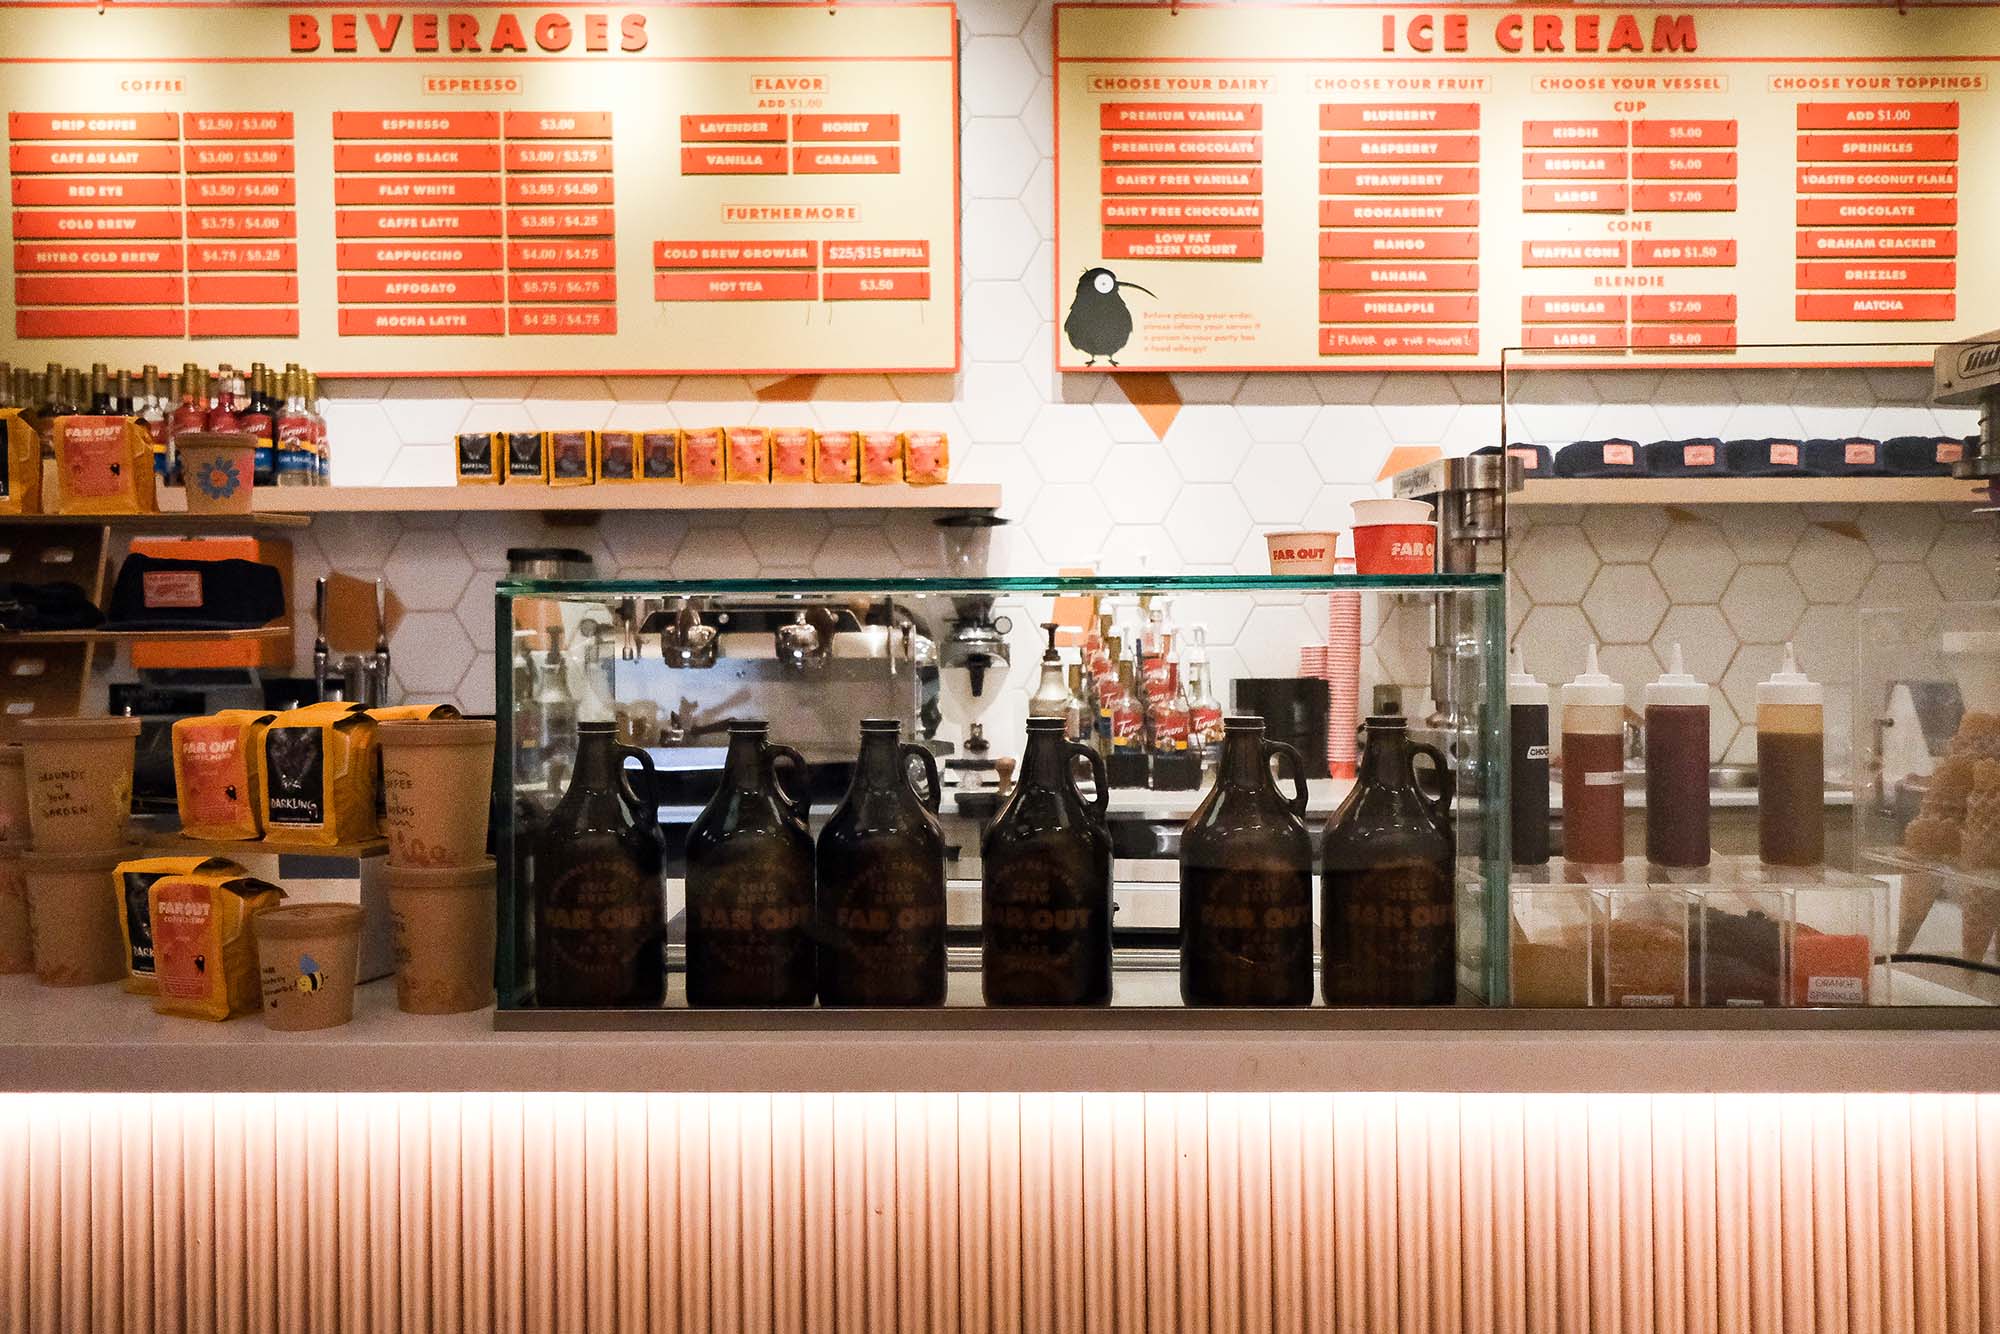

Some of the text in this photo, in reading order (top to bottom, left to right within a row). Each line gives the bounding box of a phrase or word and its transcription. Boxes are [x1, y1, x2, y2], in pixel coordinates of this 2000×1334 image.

[289, 13, 648, 52] BEVERAGES
[1382, 14, 1699, 52] ICE CREAM
[121, 80, 183, 92] COFFEE
[428, 79, 519, 91] ESPRESSO
[756, 79, 824, 90] FLAVOR
[1095, 79, 1268, 89] CHOOSE YOUR DAIRY
[1314, 79, 1485, 89] CHOOSE YOUR FRUIT
[1540, 79, 1720, 89] CHOOSE YOUR VESSEL
[1774, 77, 1982, 89] CHOOSE YOUR TOPPINGS
[758, 99, 822, 109] ADD $1.00
[1614, 101, 1647, 112] CUP
[1120, 112, 1244, 121] PREMIUM VANILLA
[1363, 110, 1437, 121] BLUEBERRY
[1847, 110, 1911, 121] ADD $1.00
[51, 120, 136, 130] DRIP COFFEE
[382, 120, 450, 130] ESPRESSO
[700, 123, 768, 133] LAVENDER
[822, 122, 869, 132] HONEY
[1112, 143, 1254, 153] PREMIUM CHOCOLATE
[1361, 143, 1438, 154] RASPBERRY
[1842, 143, 1913, 153] SPRINKLES
[51, 153, 139, 163] CAFE AU LAIT
[375, 152, 459, 162] LONG BLACK
[707, 155, 763, 165] VANILLA
[816, 155, 878, 165] CARAMEL
[1545, 160, 1606, 170] REGULAR
[1116, 176, 1249, 185] DAIRY FREE VANILLA
[1356, 175, 1444, 186] STRAWBERRY
[1802, 175, 1854, 185] TOASTED
[1858, 175, 1914, 185] COCONUT
[69, 186, 123, 197] RED EYE
[379, 185, 455, 195] FLAT WHITE
[1554, 191, 1598, 202] LARGE
[1669, 192, 1702, 202] $7.00
[727, 208, 856, 220] FURTHERMORE
[1107, 207, 1259, 217] DAIRY FREE CHOCOLATE
[1840, 206, 1915, 216] CHOCOLATE
[58, 219, 136, 229] COLD BREW
[378, 218, 459, 228] CAFFE LATTE
[1608, 221, 1653, 232] CONE
[1155, 234, 1211, 243] LOW FAT
[1373, 240, 1425, 250] MANGO
[1817, 239, 1936, 249] GRAHAM CRACKER
[522, 249, 599, 260] $4.00 $4.75
[664, 248, 808, 259] COLD BREW GROWLER
[829, 247, 924, 261] $25/$15 REFILL
[1129, 245, 1237, 255] FROZEN YOGURT
[1531, 248, 1620, 258] WAFFLE CONE
[1653, 248, 1681, 258] ADD
[37, 253, 160, 262] NITRO COLD BREW
[377, 251, 463, 261] CAPPUCCINO
[1371, 271, 1428, 282] BANANA
[1845, 270, 1907, 280] DRIZZLES
[1594, 276, 1665, 287] BLENDIE
[386, 283, 456, 294] AFFOGATO
[710, 282, 763, 292] HOT TEA
[1364, 303, 1435, 313] PINEAPPLE
[1545, 302, 1605, 313] REGULAR
[1669, 302, 1702, 313] $7.00
[1854, 301, 1904, 311] MATCHA
[376, 316, 467, 327] MOCHA LATTE
[1553, 334, 1596, 345] LARGE
[65, 426, 122, 437] FAR OUT
[1273, 548, 1325, 560] FAR OUT
[1392, 543, 1423, 556] FAR
[183, 739, 236, 754] FAR OUT
[271, 798, 318, 818] DARKLING
[158, 901, 211, 917] FAR OUT
